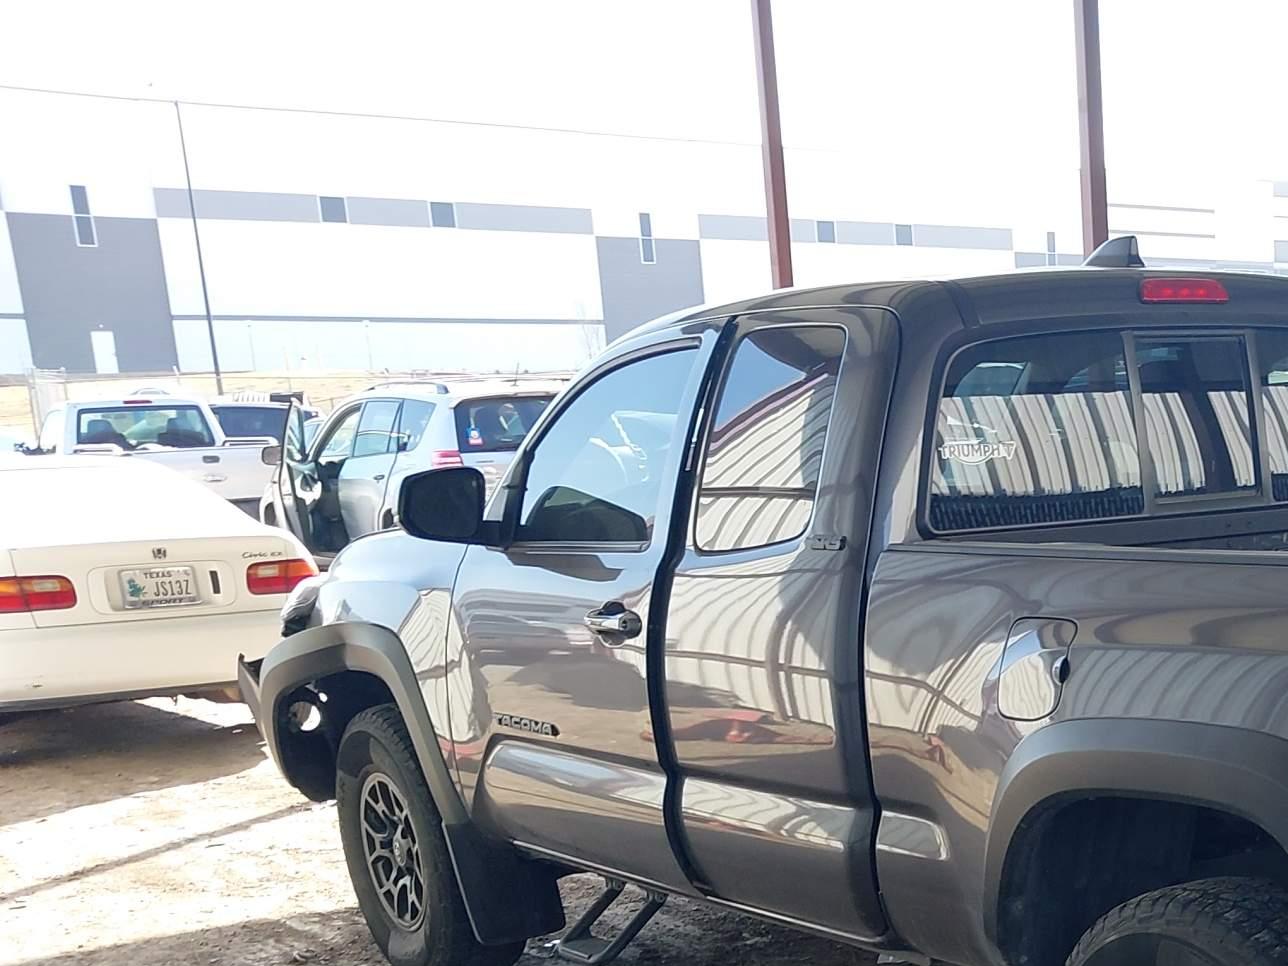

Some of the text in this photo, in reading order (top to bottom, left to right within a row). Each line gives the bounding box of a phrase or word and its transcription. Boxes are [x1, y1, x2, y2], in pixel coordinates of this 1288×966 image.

[940, 443, 1001, 459] TRIUMPH
[241, 551, 269, 559] Civic
[143, 570, 173, 579] TEXAS
[153, 579, 193, 597] JS13Z
[495, 714, 553, 736] TACOMA
